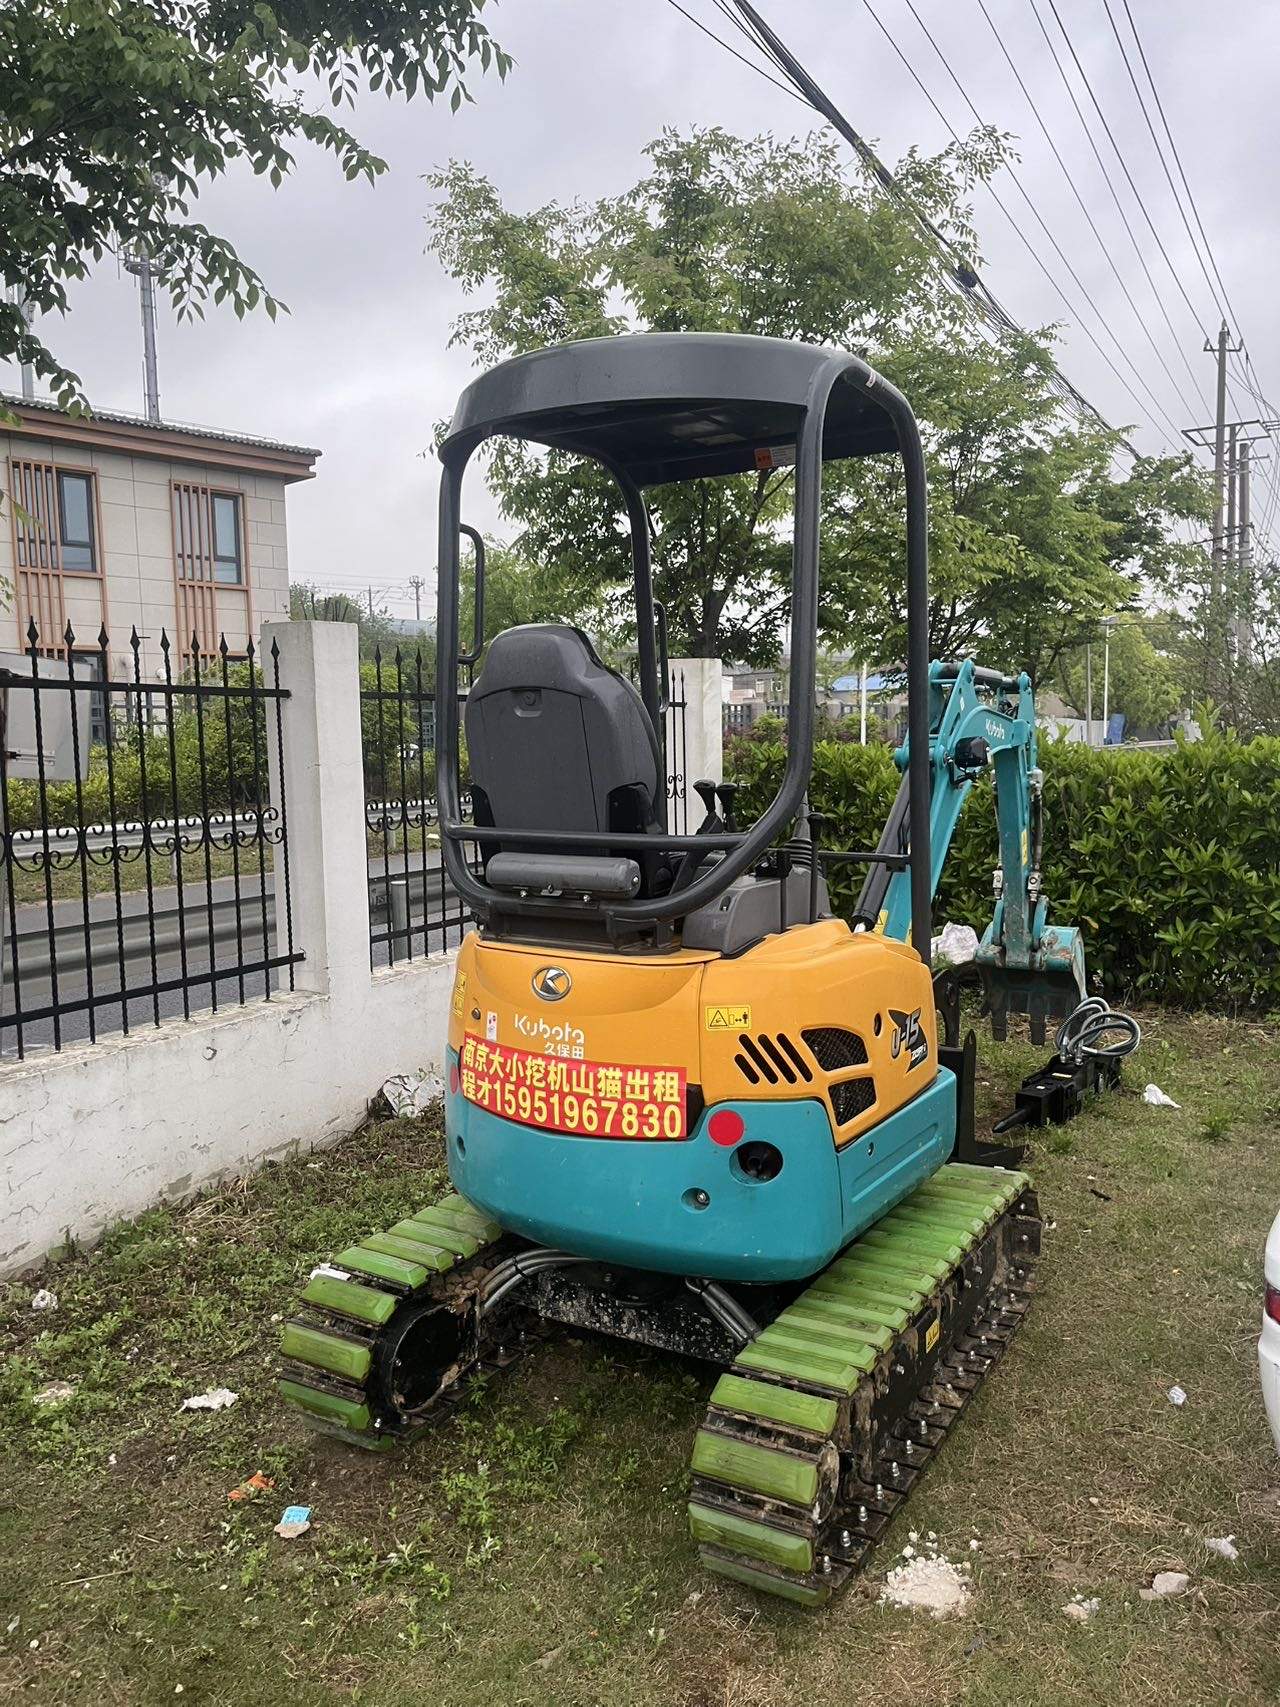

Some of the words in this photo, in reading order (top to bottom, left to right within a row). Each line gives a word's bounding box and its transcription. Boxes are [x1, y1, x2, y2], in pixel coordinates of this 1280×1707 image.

[514, 1013, 585, 1044] Kubota
[544, 1041, 584, 1059] 久保田
[463, 1037, 681, 1103] 南京大小挖机山猫出租
